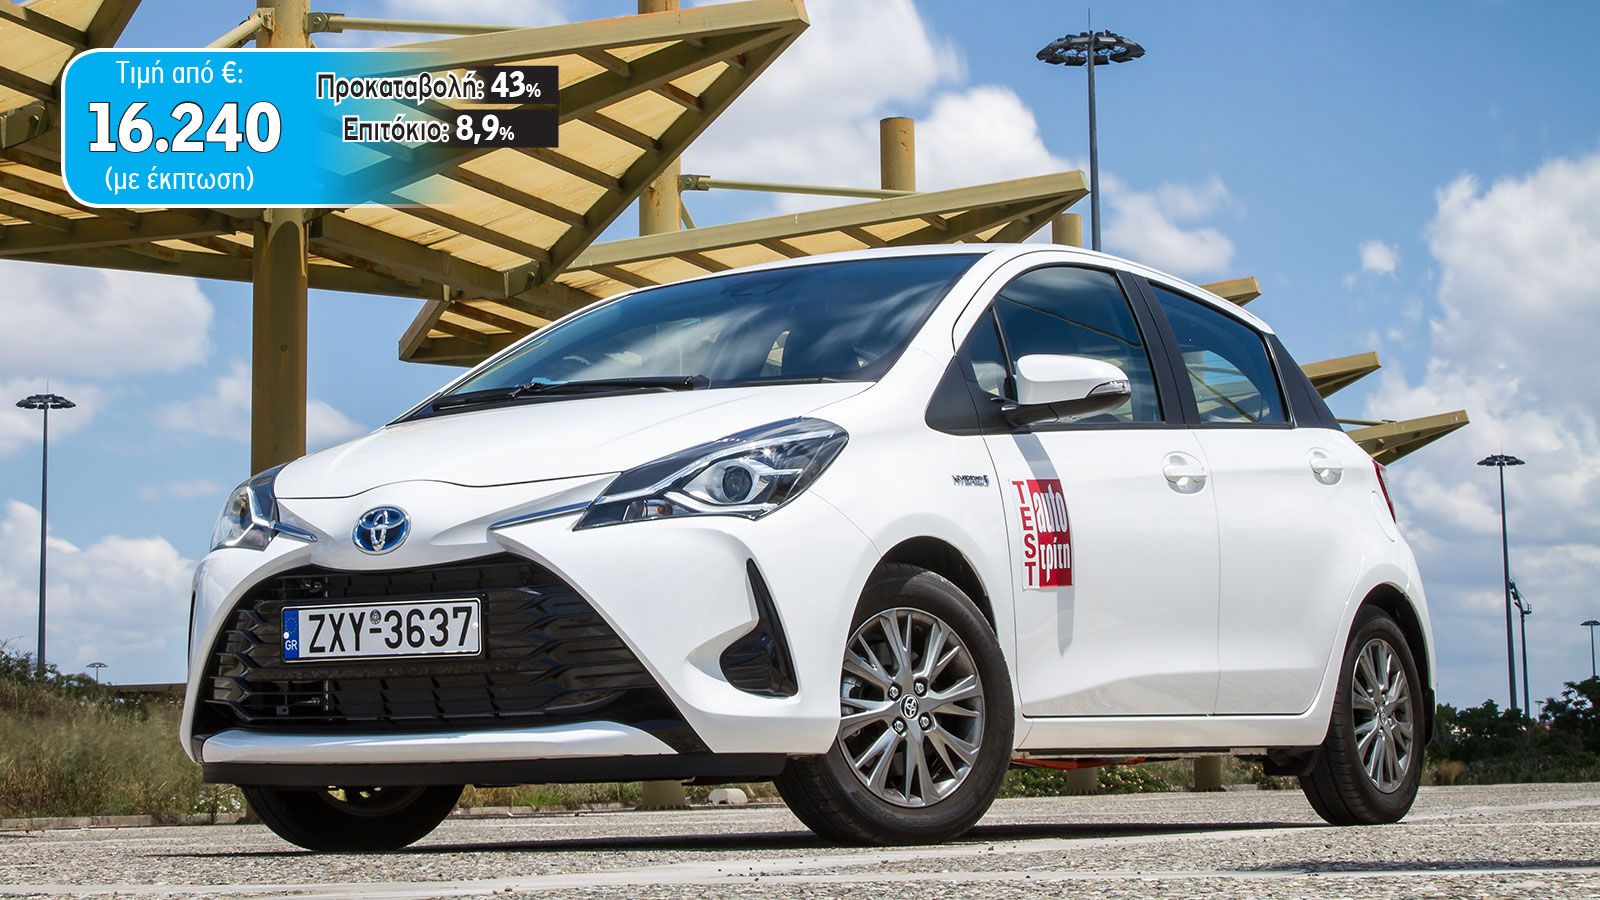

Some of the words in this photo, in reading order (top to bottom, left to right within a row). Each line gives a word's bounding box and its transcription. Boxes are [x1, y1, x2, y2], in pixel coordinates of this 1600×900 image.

[1032, 483, 1068, 533] auto
[1012, 480, 1037, 586] TEST
[1040, 537, 1070, 583] τρίτη
[285, 639, 298, 651] GR
